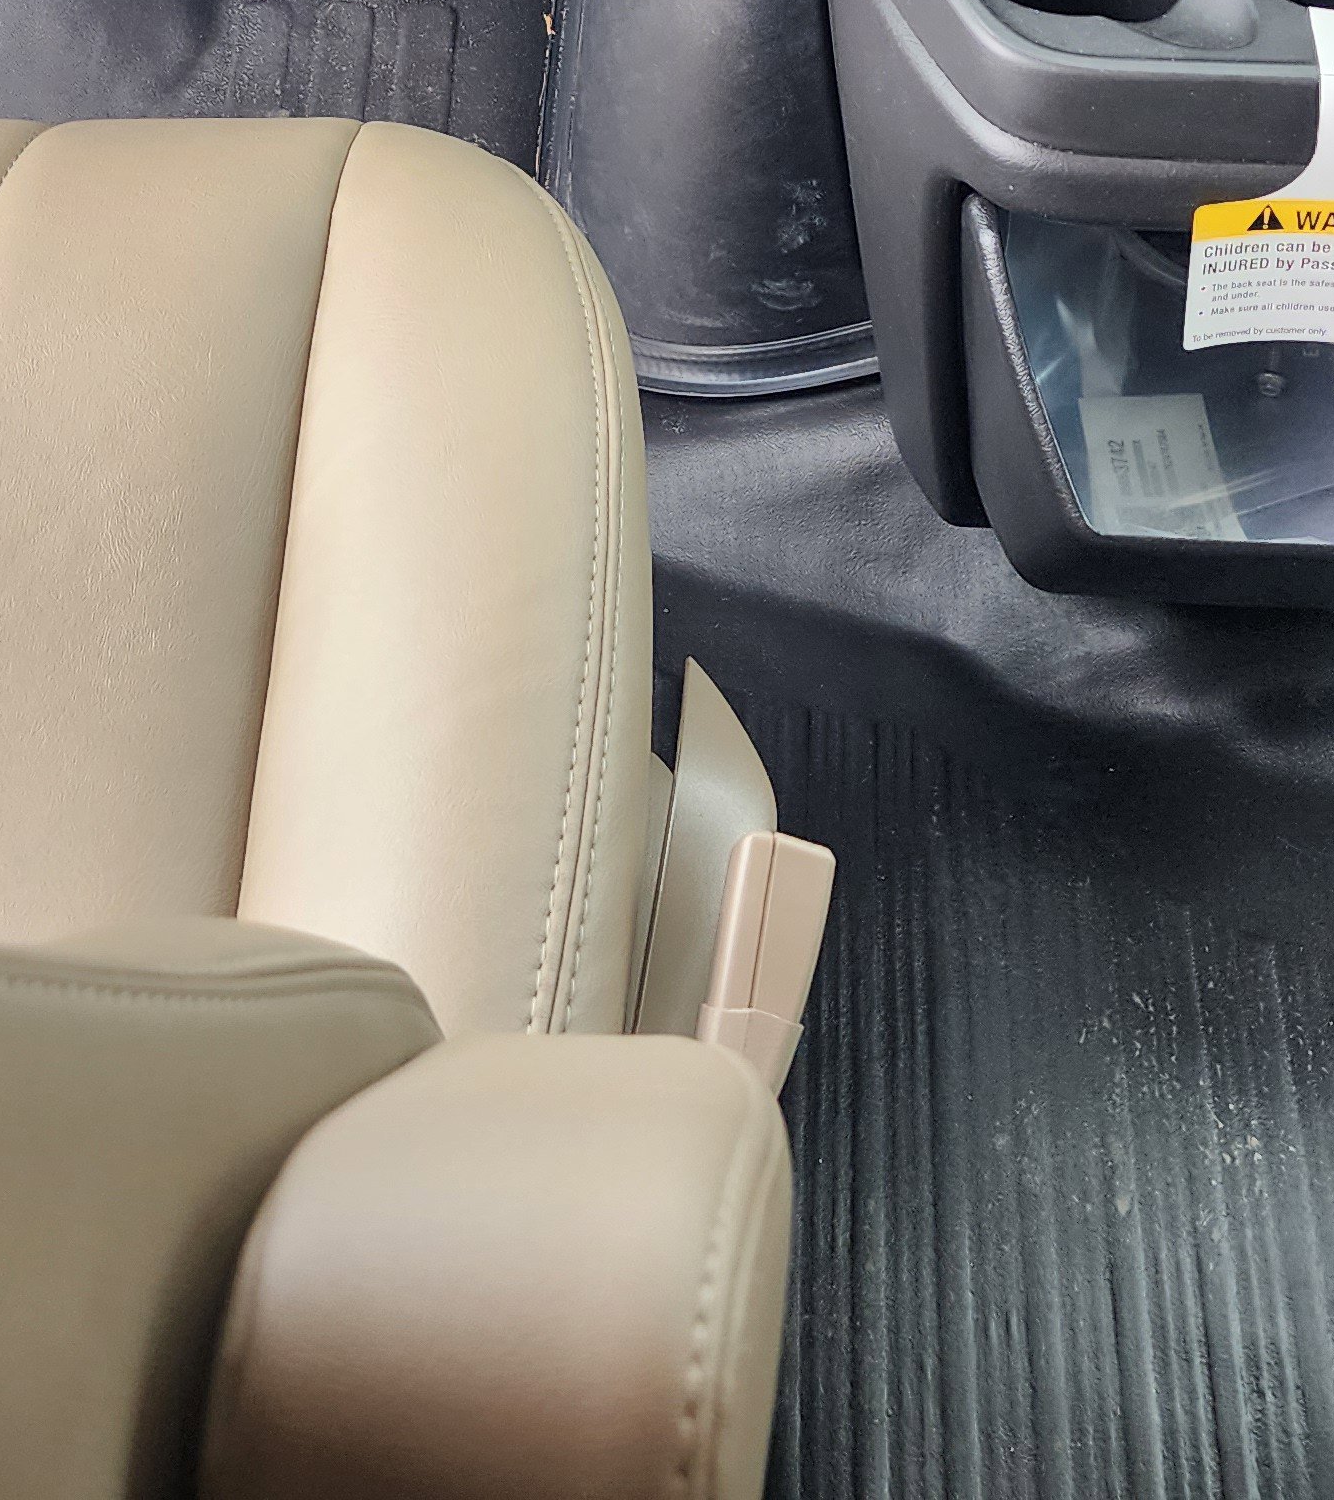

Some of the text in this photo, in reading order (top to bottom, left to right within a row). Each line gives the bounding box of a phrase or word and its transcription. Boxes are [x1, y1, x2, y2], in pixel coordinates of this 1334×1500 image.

[1204, 242, 1270, 258] Children
[1276, 242, 1305, 253] can
[1311, 241, 1331, 253] be
[1202, 258, 1269, 275] INJURED
[1276, 257, 1295, 271] by
[1212, 283, 1228, 292] The
[1231, 280, 1253, 289] back
[1256, 279, 1277, 287] seat
[1279, 279, 1288, 287] is
[1291, 279, 1306, 287] the
[1211, 293, 1228, 302] and
[1210, 306, 1235, 316] Make
[1261, 303, 1273, 311] all
[1276, 303, 1315, 311] children
[1192, 334, 1201, 342] To
[1203, 332, 1214, 341] be
[1216, 328, 1251, 339] removed
[1253, 328, 1263, 336] by
